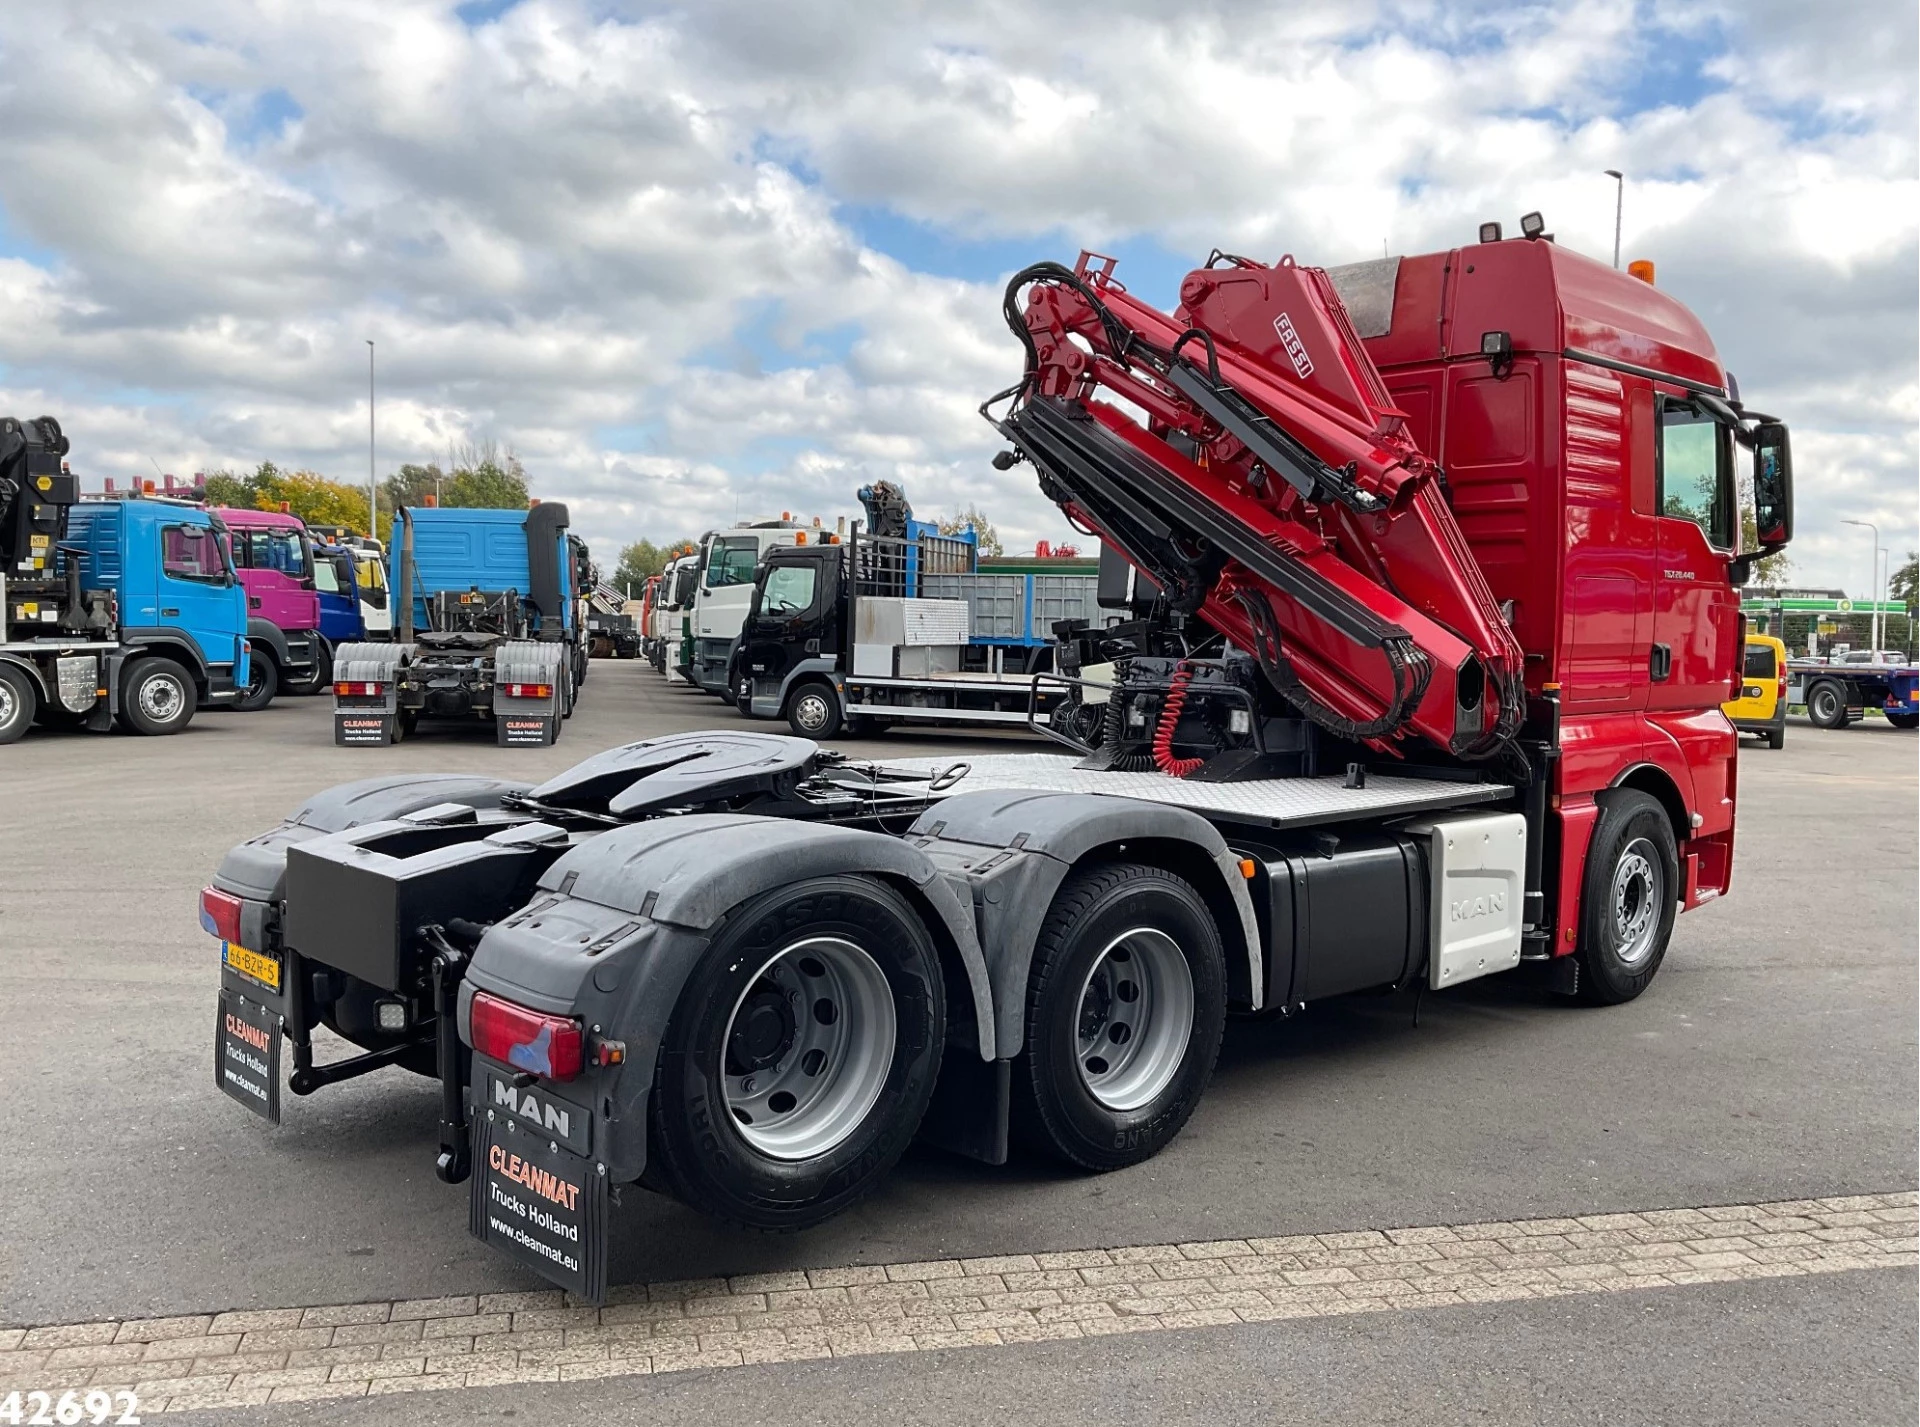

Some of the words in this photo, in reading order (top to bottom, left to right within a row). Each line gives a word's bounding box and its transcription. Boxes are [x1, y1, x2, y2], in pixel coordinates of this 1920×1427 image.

[1278, 318, 1309, 372] FASSI
[343, 720, 382, 728] CLEANMAT
[506, 721, 543, 729] CLEANMAT
[1451, 892, 1505, 922] MAN
[230, 948, 275, 981] 66-BZR-5
[226, 1013, 270, 1054] CLEANMAT
[226, 1041, 246, 1064] Trucks
[246, 1052, 268, 1078] Holland
[224, 1067, 268, 1101] www.cleanmat.eu
[495, 1079, 569, 1138] MAN
[489, 1144, 580, 1211] CLEANMAT
[490, 1181, 526, 1218] Trucks
[529, 1204, 578, 1242] Holland
[490, 1215, 578, 1272] www.cleanmat.eu
